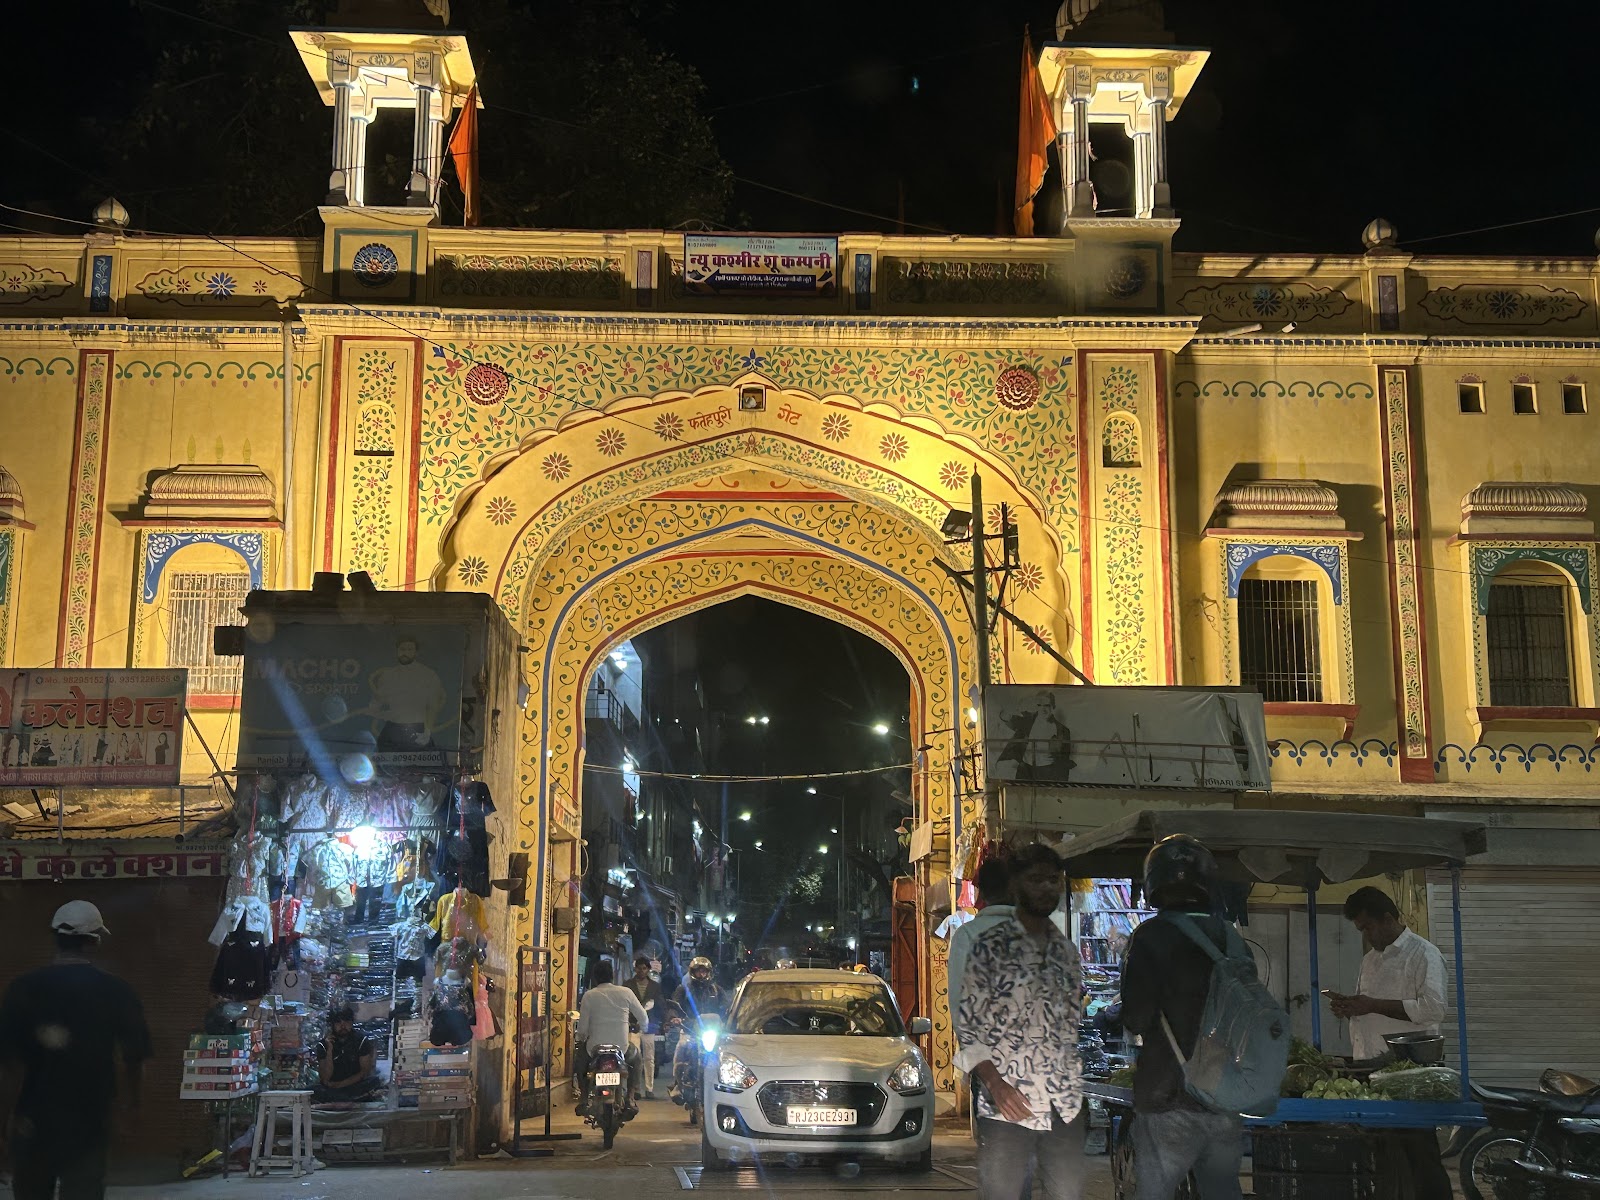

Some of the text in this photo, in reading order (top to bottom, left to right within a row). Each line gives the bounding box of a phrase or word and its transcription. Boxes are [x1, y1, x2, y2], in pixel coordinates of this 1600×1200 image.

[690, 251, 832, 273] न्यू कश्मीर शू कम्पनी
[688, 403, 802, 431] फतेहपुरी गेट
[252, 658, 361, 680] MACHO
[21, 685, 178, 728] कलेक्शन
[795, 1111, 855, 1123] RJ23CE2931
